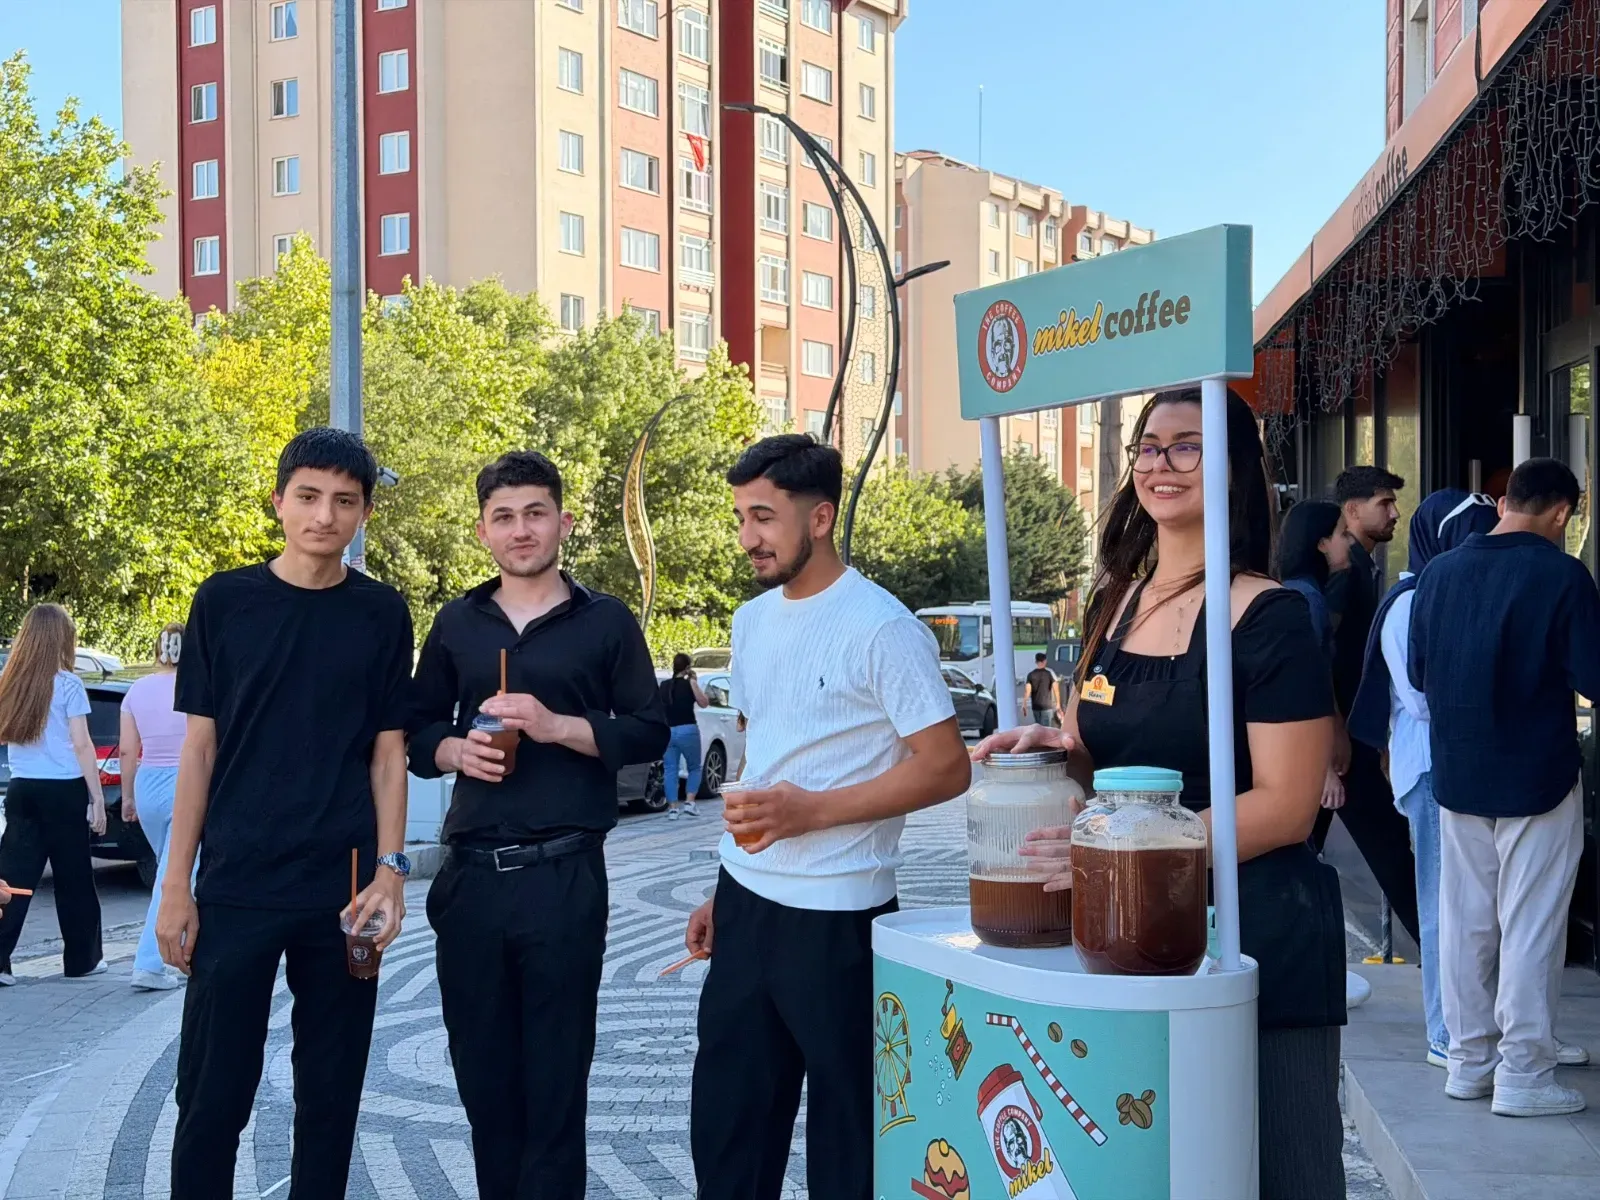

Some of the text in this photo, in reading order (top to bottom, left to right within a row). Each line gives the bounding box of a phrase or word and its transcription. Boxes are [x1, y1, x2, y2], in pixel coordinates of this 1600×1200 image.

[1375, 145, 1408, 212] coffee
[982, 303, 1021, 331] THE COFFEE
[1033, 289, 1191, 356] mikel coffee
[986, 365, 1022, 390] COMPANY
[1007, 1108, 1033, 1127] COMPANY
[1009, 1147, 1053, 1199] mikel
